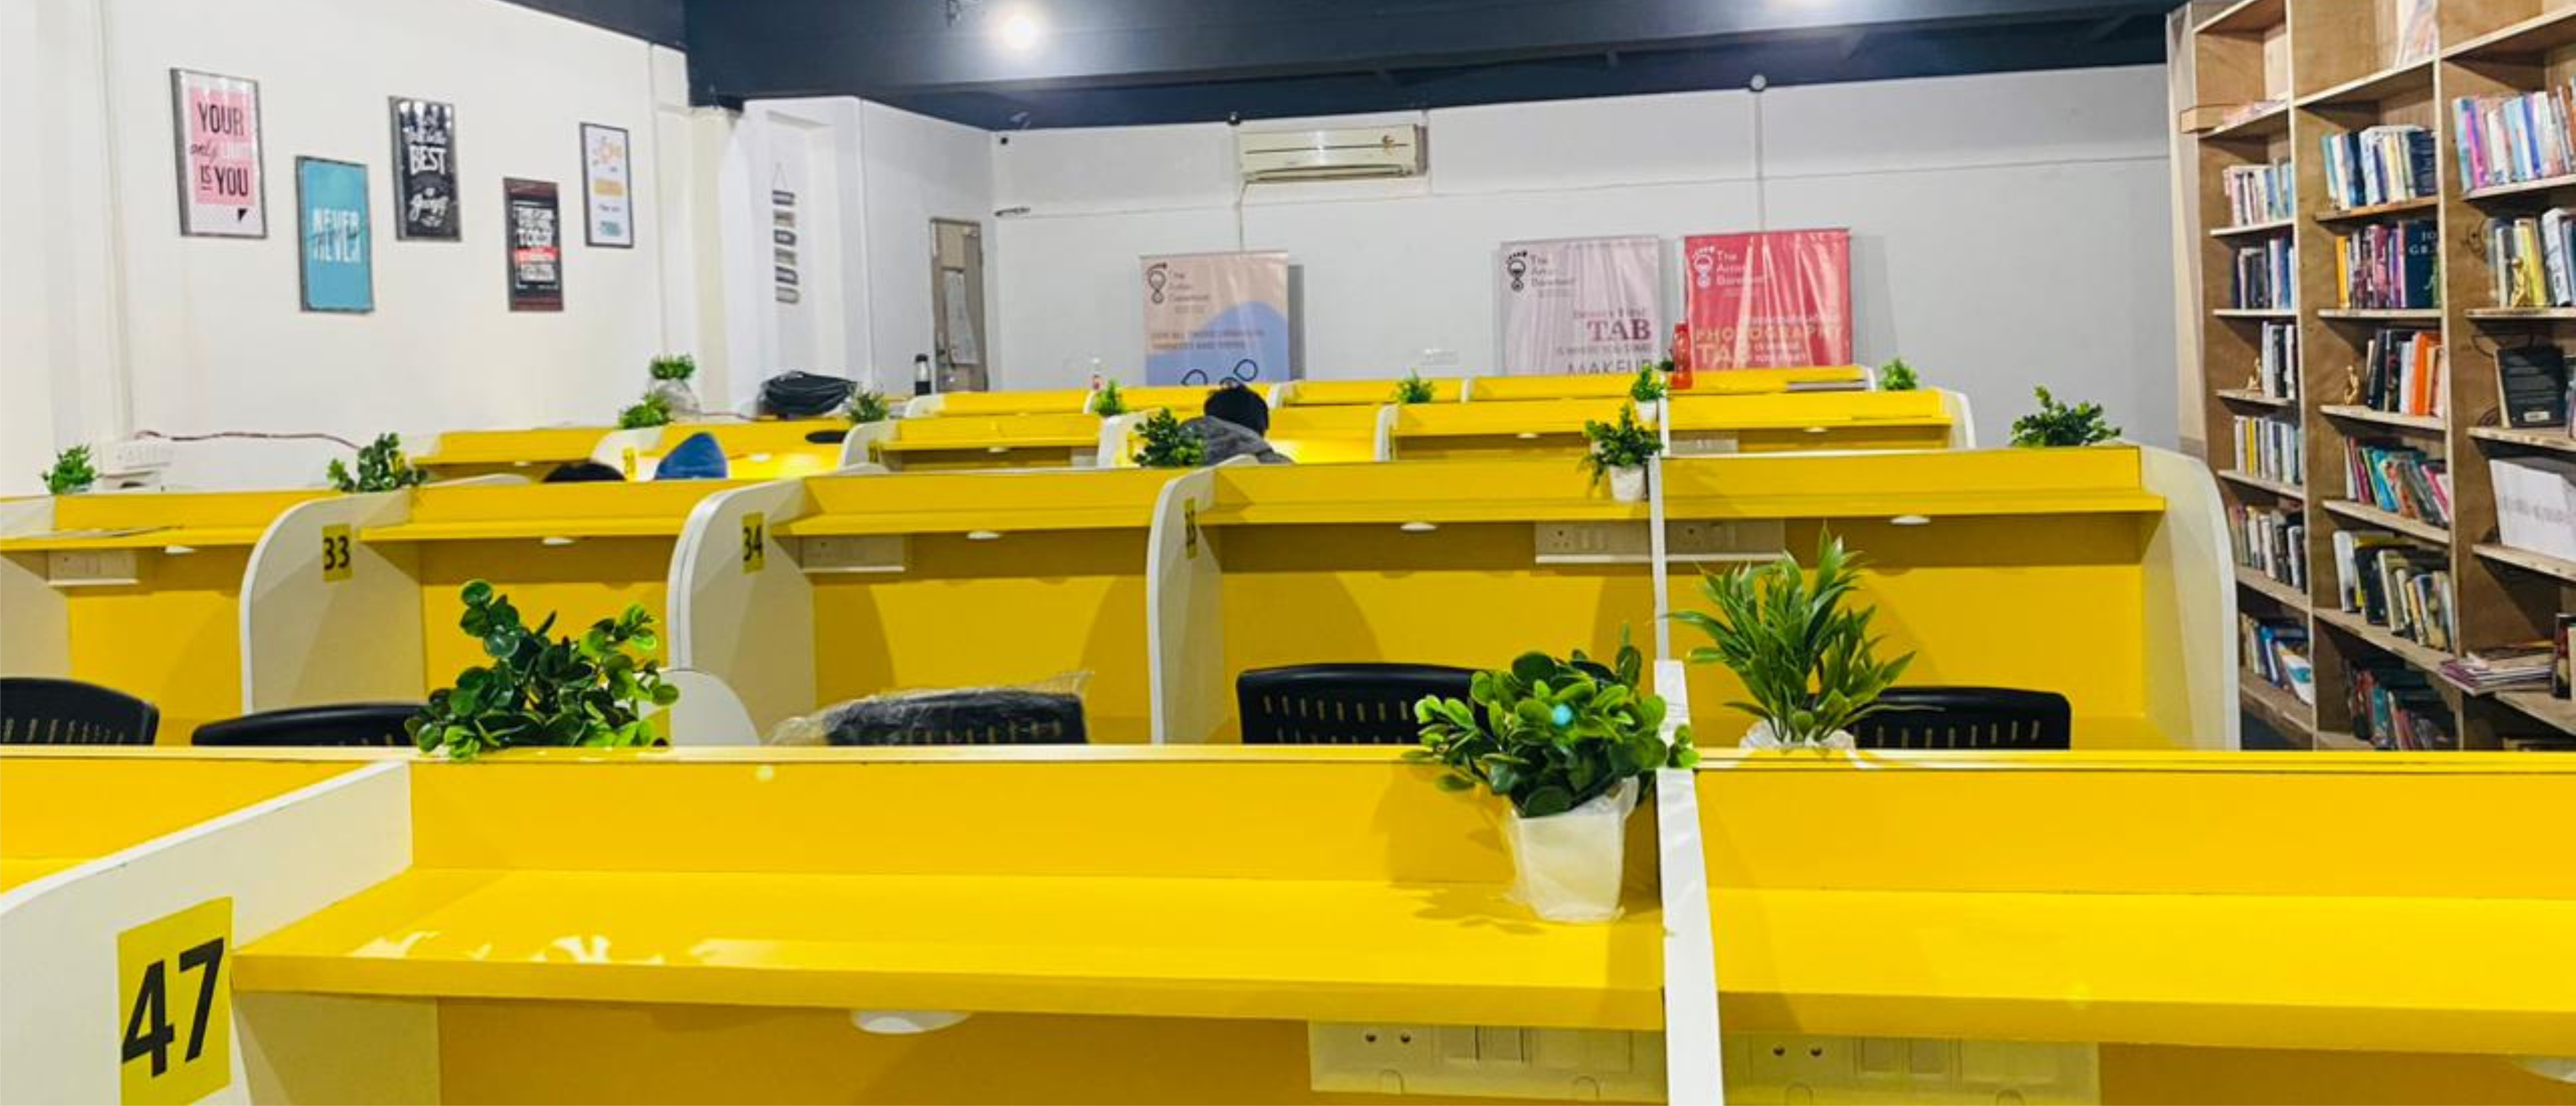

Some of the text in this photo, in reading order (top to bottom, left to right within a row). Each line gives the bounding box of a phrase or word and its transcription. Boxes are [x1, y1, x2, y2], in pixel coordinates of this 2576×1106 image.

[197, 102, 244, 136] YOUR
[409, 145, 447, 175] BEST
[200, 165, 248, 196] IS YOU
[1587, 318, 1651, 341] TAB
[323, 535, 351, 570] 33
[743, 524, 763, 561] 34
[121, 937, 224, 1078] 47
